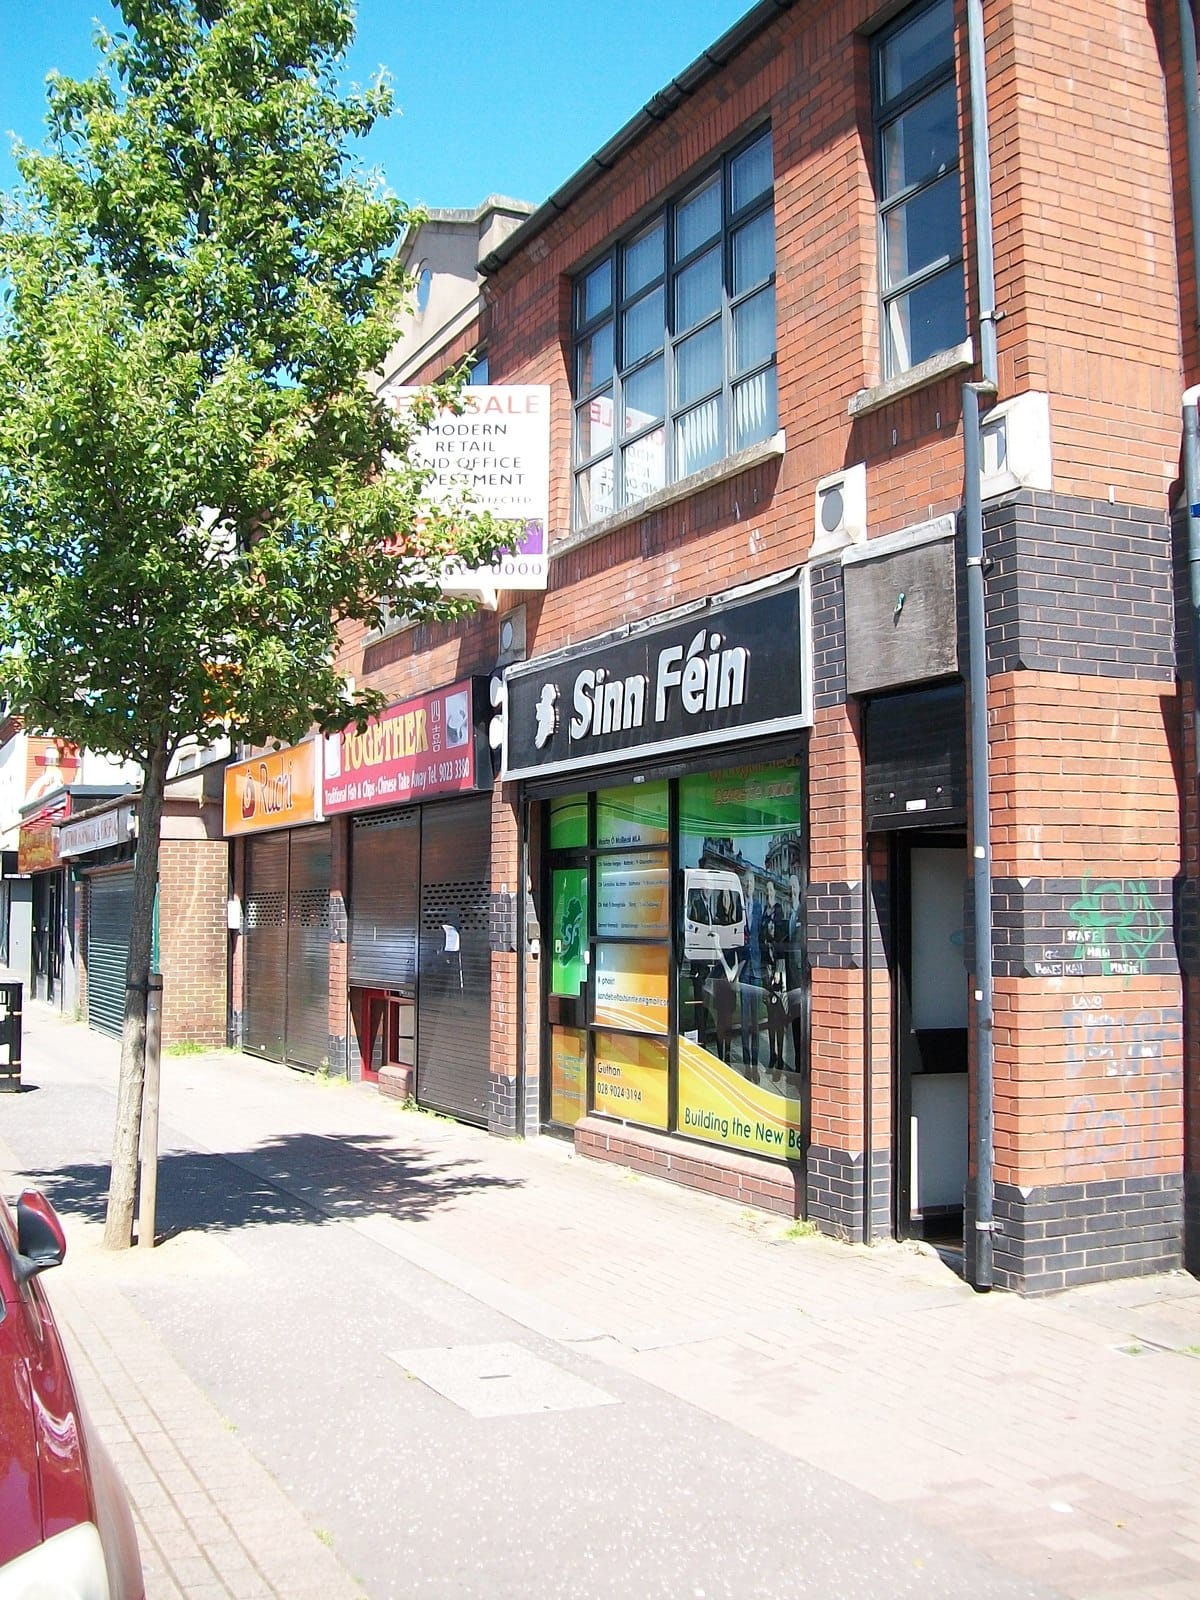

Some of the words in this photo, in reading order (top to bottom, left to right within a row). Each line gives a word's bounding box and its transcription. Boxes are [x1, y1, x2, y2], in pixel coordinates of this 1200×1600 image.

[466, 394, 540, 414] SALE
[426, 424, 507, 436] MODERN
[436, 441, 495, 452] RETAIL
[457, 456, 522, 470] OFFICE
[418, 473, 526, 486] VESTMENT
[570, 668, 648, 740] Sinn
[655, 629, 749, 722] Féin
[342, 709, 429, 772] TOGETHER
[258, 757, 294, 817] Ruchi
[324, 786, 347, 805] Traditional
[347, 783, 357, 801] Fish
[363, 779, 375, 801] Chips
[377, 774, 397, 795] Chinese
[398, 771, 410, 789] Take
[411, 770, 427, 791] Away
[439, 760, 453, 782] 9023
[597, 1082, 608, 1096] 028
[610, 1085, 625, 1098] 9024
[626, 1088, 642, 1102] 3194
[685, 1107, 729, 1138] Building
[732, 1116, 751, 1138] the
[755, 1122, 784, 1145] New
